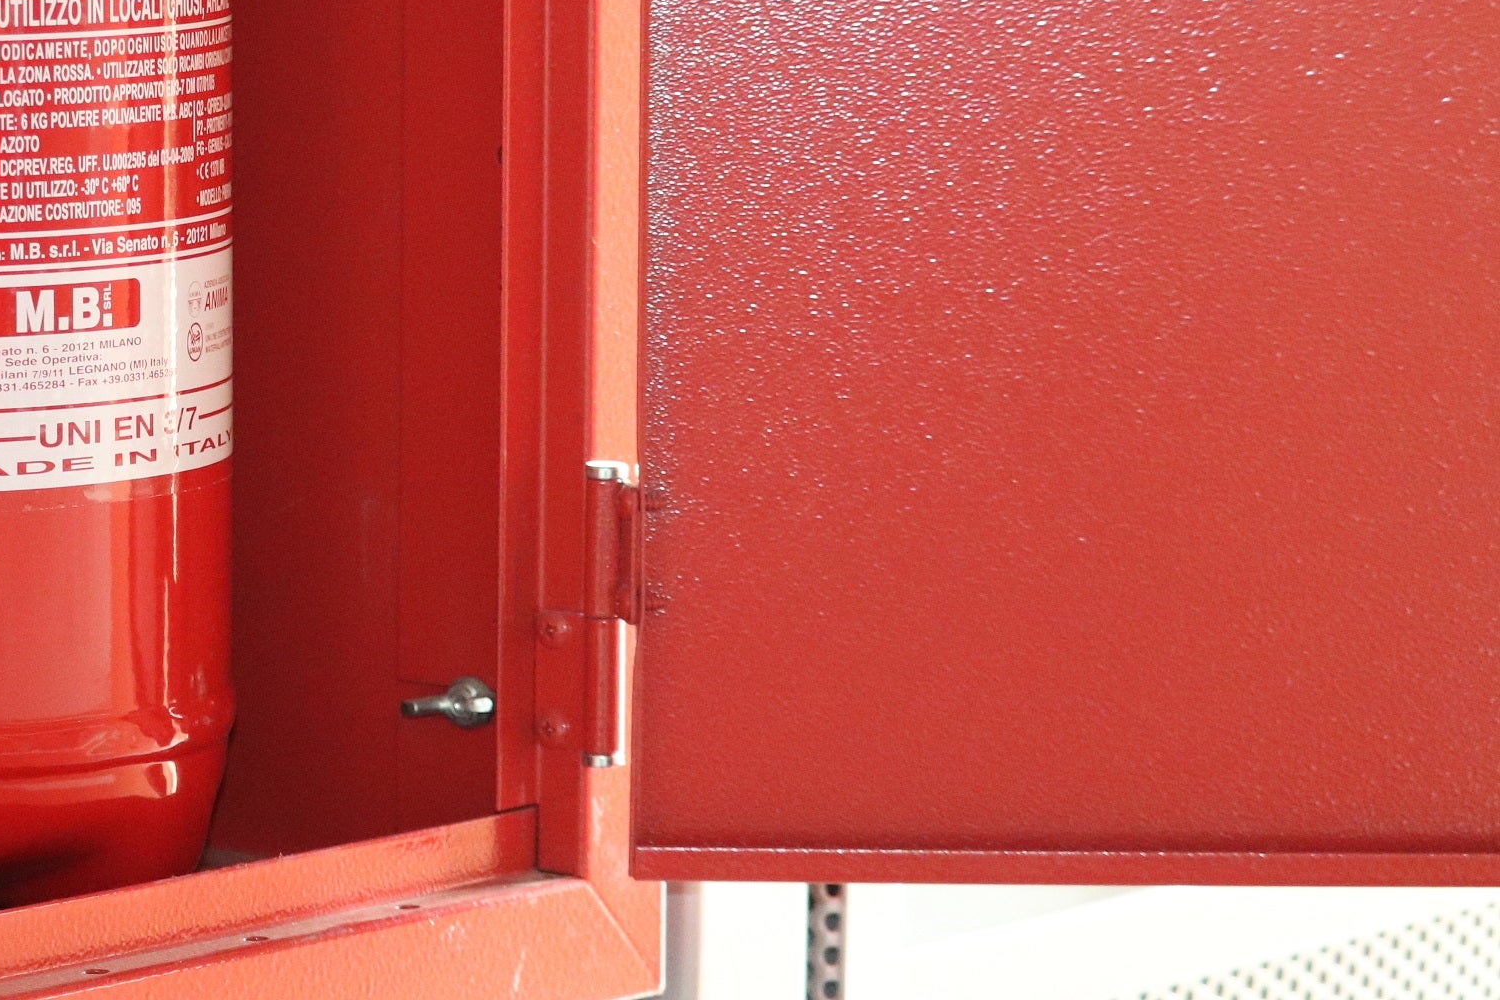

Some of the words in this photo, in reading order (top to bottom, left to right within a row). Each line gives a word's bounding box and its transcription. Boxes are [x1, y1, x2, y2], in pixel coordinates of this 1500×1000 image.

[94, 38, 125, 57] DOPO
[128, 37, 153, 55] OGNI
[180, 29, 208, 51] QUANDO
[18, 65, 51, 84] ZONA
[53, 63, 94, 82] ROSSA.
[103, 58, 155, 79] UTILIZZARE
[54, 85, 111, 105] PRODOTTO
[113, 80, 164, 102] APPROVATO
[21, 113, 28, 130] 6
[31, 112, 48, 130] KG
[51, 109, 99, 129] POLVERE
[102, 104, 161, 126] POLIVALENTE
[179, 101, 193, 120] ABC
[0, 135, 40, 154] AZOTO
[78, 155, 100, 173] UFF.
[12, 182, 23, 199] DI
[26, 179, 78, 199] UTILIZZO:
[102, 177, 109, 194] C
[132, 174, 139, 192] C
[45, 198, 124, 221] COSTRUTTORE:
[126, 197, 141, 215] 095
[10, 244, 46, 261] M.B.
[92, 238, 114, 256] Via
[117, 235, 158, 253] Senato
[187, 224, 208, 245] 20121
[103, 284, 112, 310] SRL
[62, 342, 95, 353] 20121
[99, 336, 142, 350] MILANO
[5, 358, 37, 367] Sede
[42, 353, 103, 366] Operativa:
[69, 362, 126, 376] LEGNANO
[78, 377, 98, 387] Fax
[39, 418, 101, 449] UNI
[115, 413, 154, 441] EN
[114, 448, 157, 467] IN
